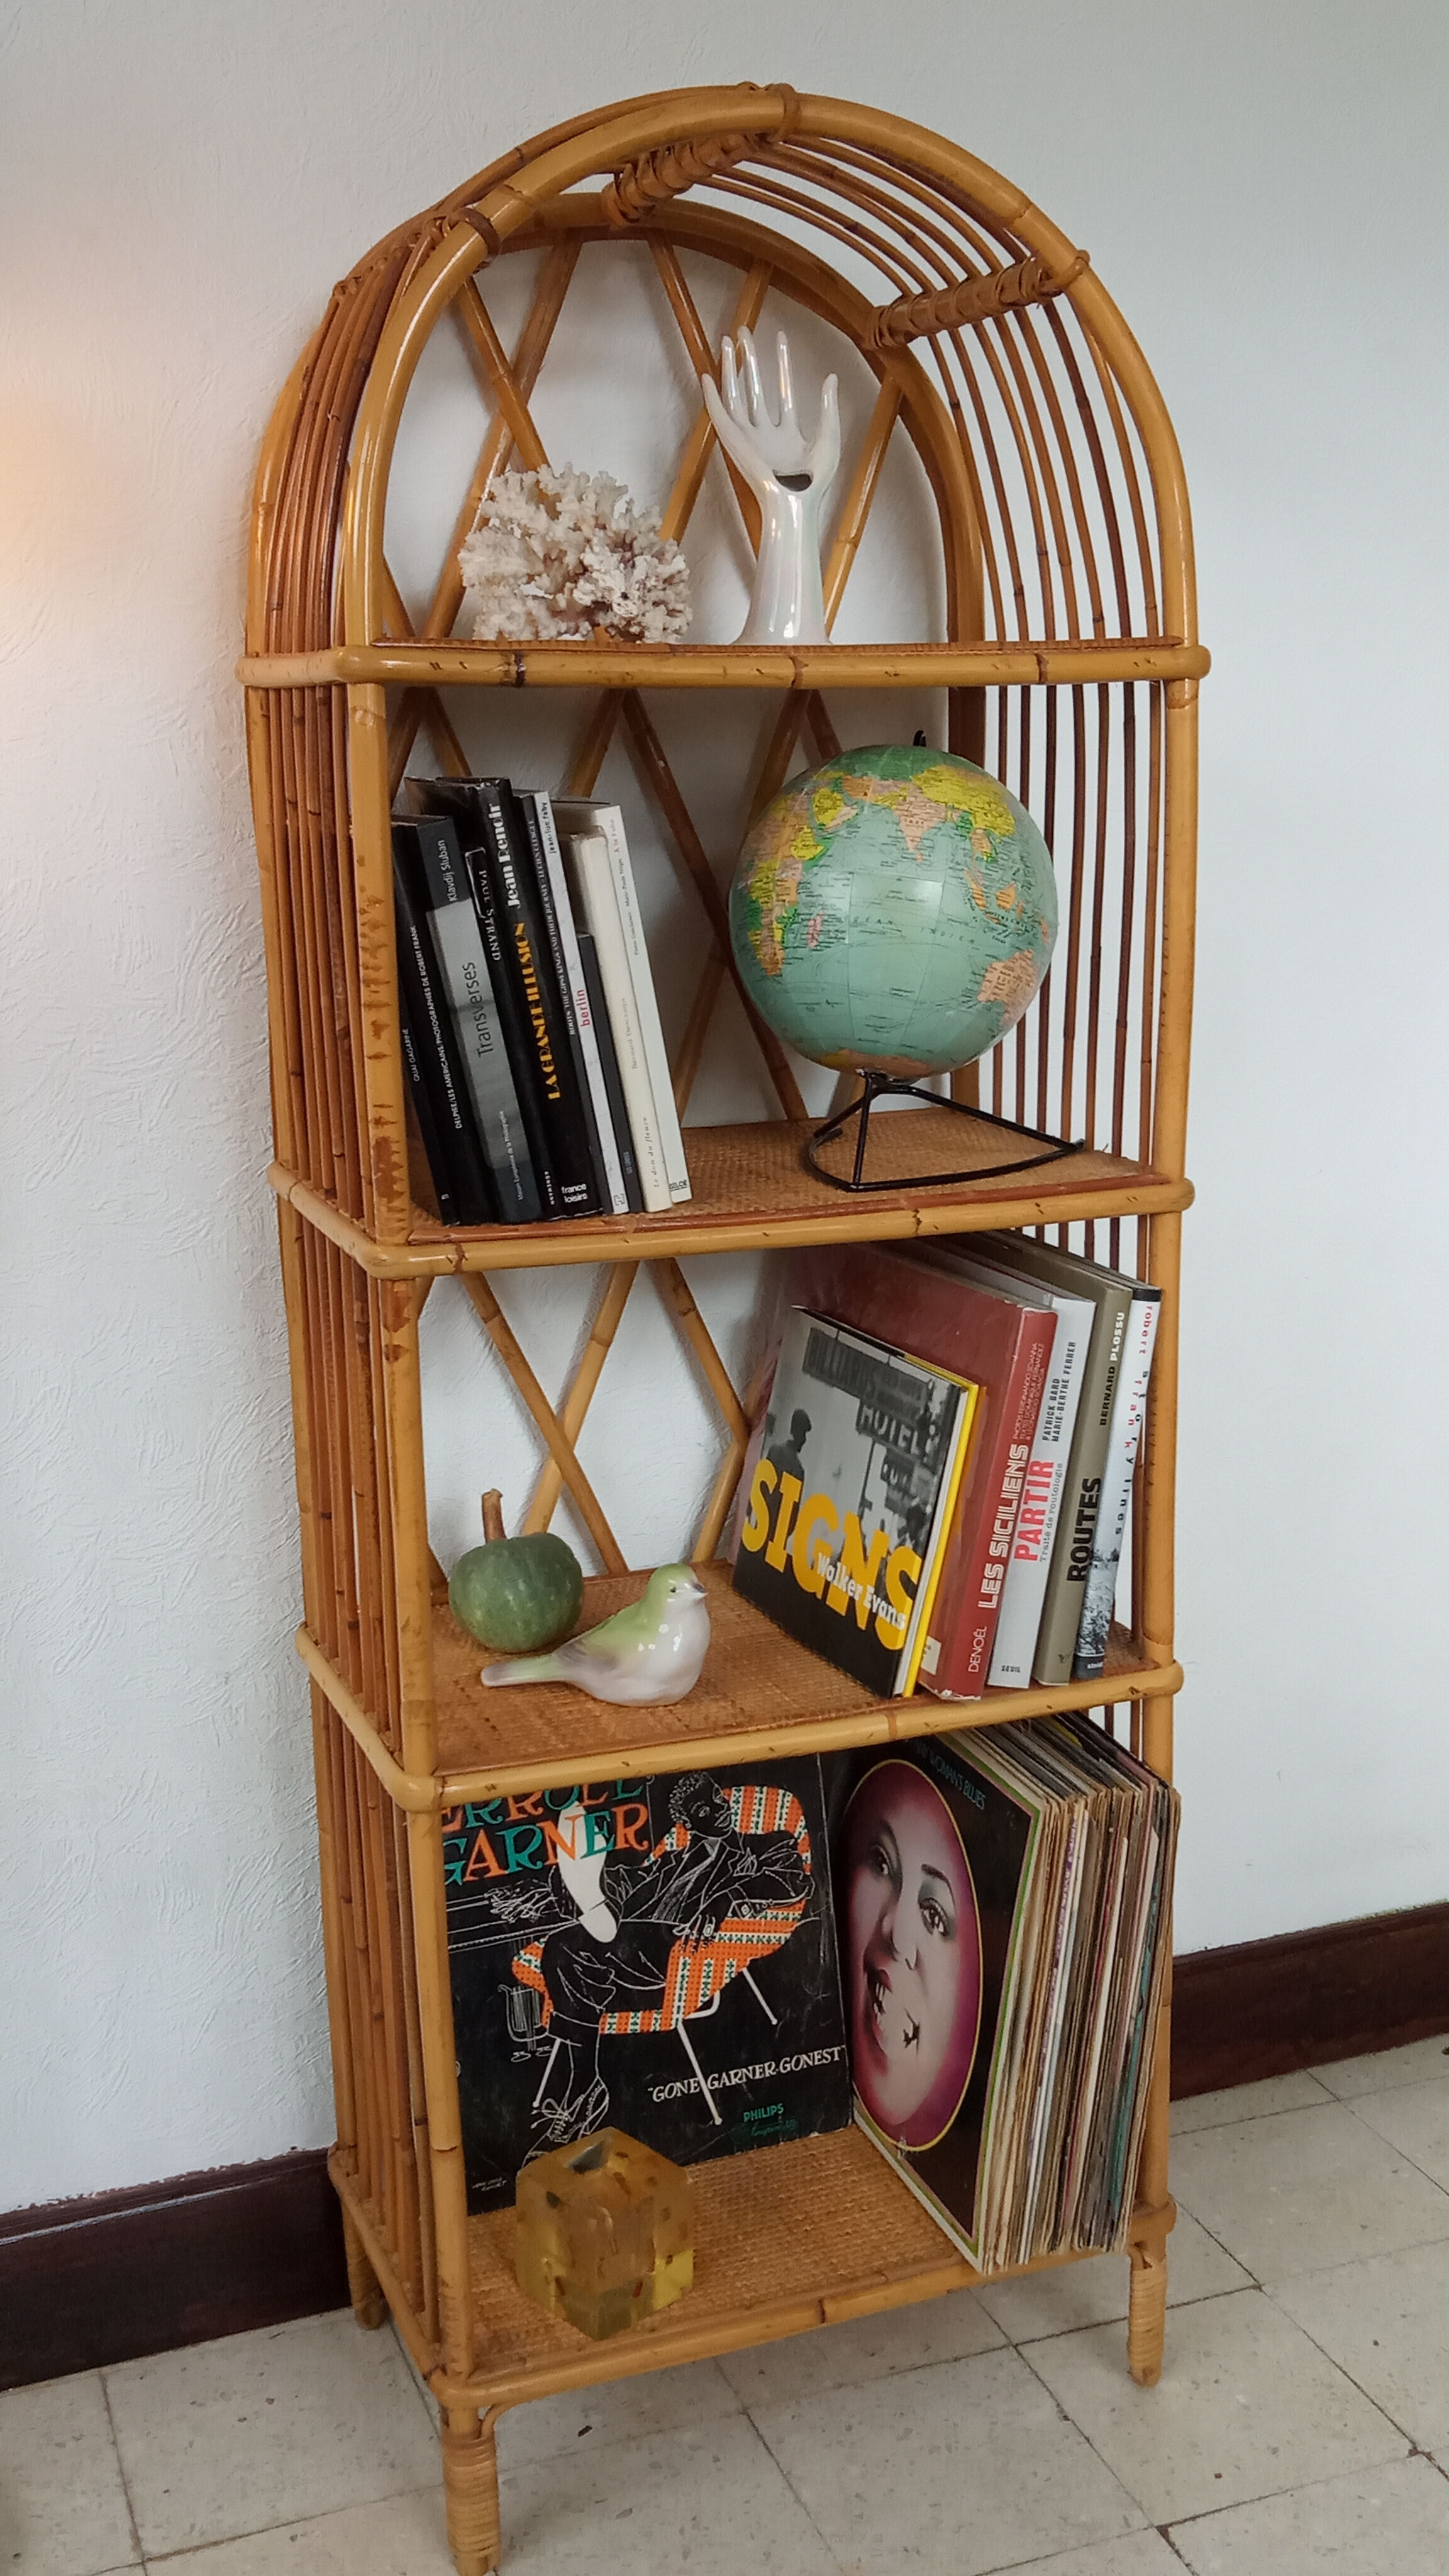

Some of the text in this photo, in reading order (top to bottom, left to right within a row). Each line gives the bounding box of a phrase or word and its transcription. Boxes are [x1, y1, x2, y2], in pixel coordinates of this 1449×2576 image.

[437, 839, 458, 902] Klavdij Sluban
[489, 803, 521, 909] Jean Renoir
[409, 924, 421, 950] FRANK
[479, 870, 502, 961] PAUL STRAND
[414, 950, 426, 976] ROBERT
[421, 976, 430, 987] DE
[462, 962, 494, 1058] Transverses
[514, 923, 560, 1099] LA GRANDE ILLUSION
[575, 989, 591, 1027] berlin
[561, 1183, 587, 1194] france
[564, 1192, 588, 1204] loisirs
[1052, 1341, 1076, 1441] MARIE-BERTHE FERRER
[1099, 1312, 1125, 1425] BERNARD PLOSSU
[1124, 1305, 1153, 1448] robert frank
[1042, 1378, 1060, 1441] PATRICK BARD
[977, 1443, 1030, 1611] LES SICILIENS
[1014, 1459, 1055, 1563] PARTIR
[1044, 1516, 1053, 1529] de
[1048, 1461, 1063, 1514] routologie
[741, 1458, 922, 1651] SIGNS
[1067, 1475, 1101, 1583] ROUTES
[816, 1552, 907, 1631] Walker Evans
[962, 1779, 987, 1811] BLUES
[443, 1803, 649, 1885] GARNER
[743, 2103, 784, 2123] PHILIPS
